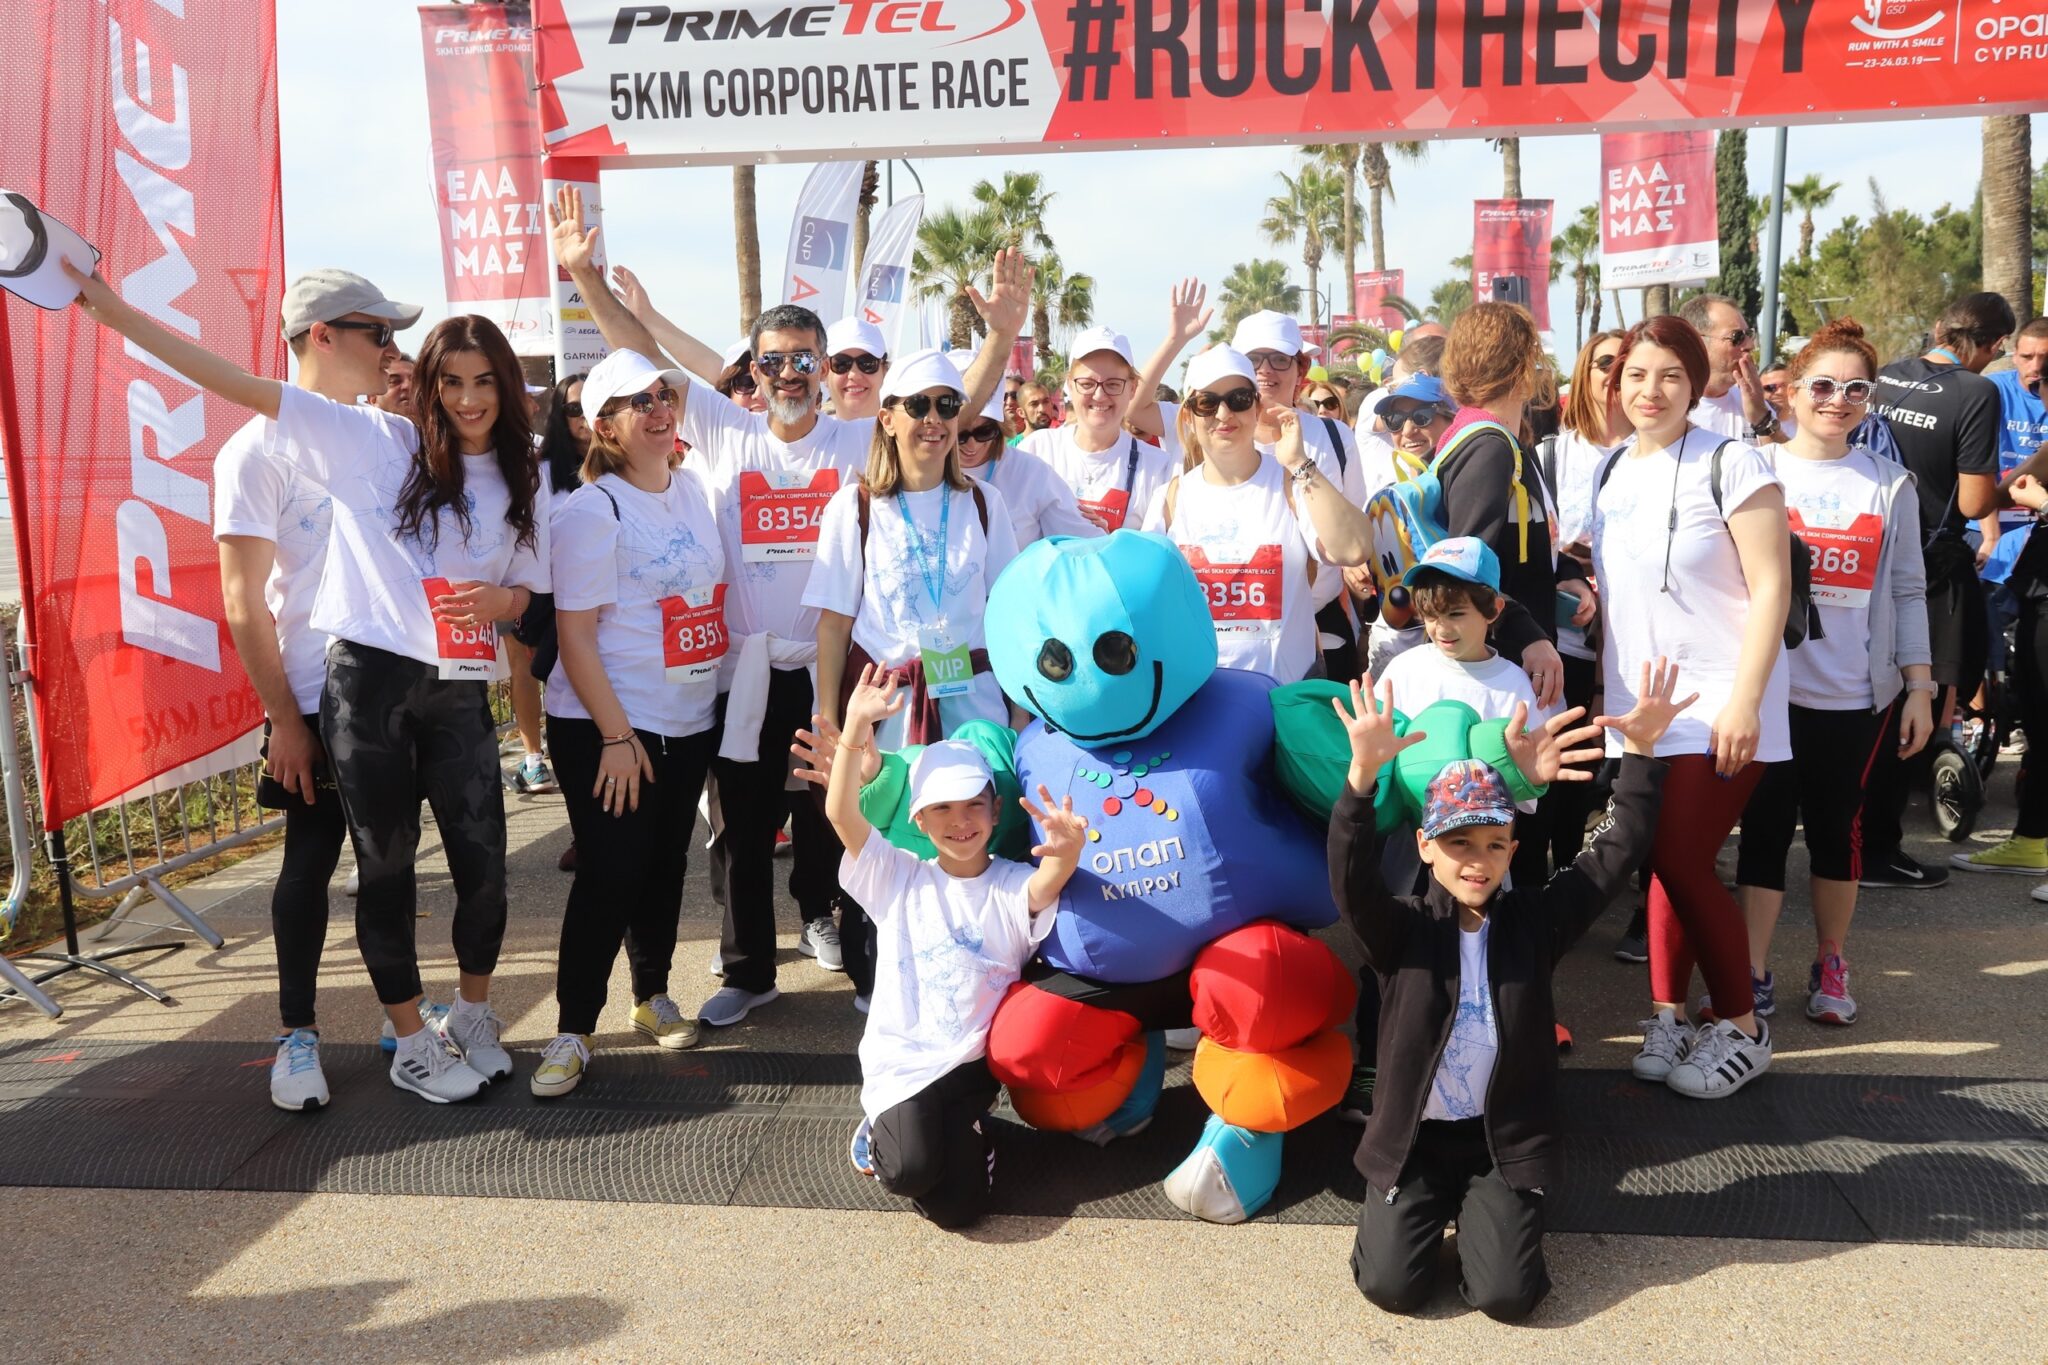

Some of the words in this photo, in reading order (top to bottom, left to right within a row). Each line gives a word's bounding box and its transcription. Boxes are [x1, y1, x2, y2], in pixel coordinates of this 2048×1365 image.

[435, 26, 533, 44] PRIMETE
[1848, 42, 1870, 51] RUN
[1873, 40, 1899, 50] WITH
[1901, 40, 1909, 48] A
[1912, 37, 1945, 47] SMILE
[1975, 45, 2048, 63] CYPRU
[610, 71, 692, 121] 5KM
[703, 62, 920, 117] CORPORATE
[931, 57, 1029, 110] RACE
[447, 166, 518, 202] ΕΛΑ
[1608, 161, 1669, 190] ΕΛΑ
[1609, 184, 1686, 215] ΜΑΖΙ
[450, 203, 541, 240] ΜΑΖΙ
[1610, 209, 1673, 238] ΜΑΣ
[802, 221, 815, 261] CNP
[454, 241, 524, 277] ΜΑΣ
[870, 267, 880, 297] CNP
[563, 352, 607, 361] GARMIN
[758, 506, 823, 531] 8354
[1821, 533, 1856, 542] CORPORATE
[1858, 536, 1874, 544] RACE
[1809, 545, 1859, 574] 368
[679, 621, 722, 652] 8351
[931, 658, 964, 680] VIP
[1101, 870, 1180, 901] ΚΥΠΡΟΥ
